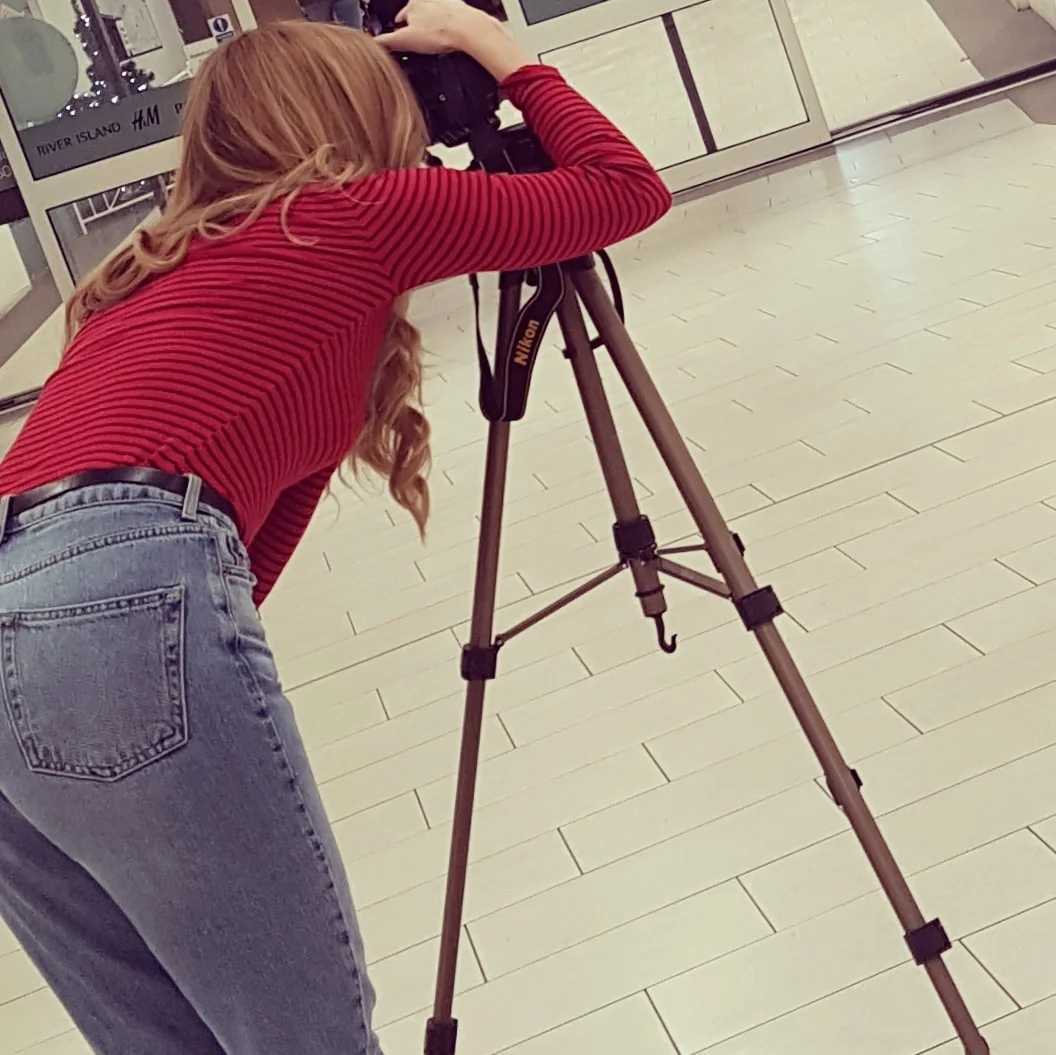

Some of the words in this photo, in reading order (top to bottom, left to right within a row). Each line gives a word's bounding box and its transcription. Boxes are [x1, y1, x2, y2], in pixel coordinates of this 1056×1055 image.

[37, 137, 72, 156] RIVER
[76, 122, 121, 144] ISLAND
[514, 319, 540, 366] Nikon
